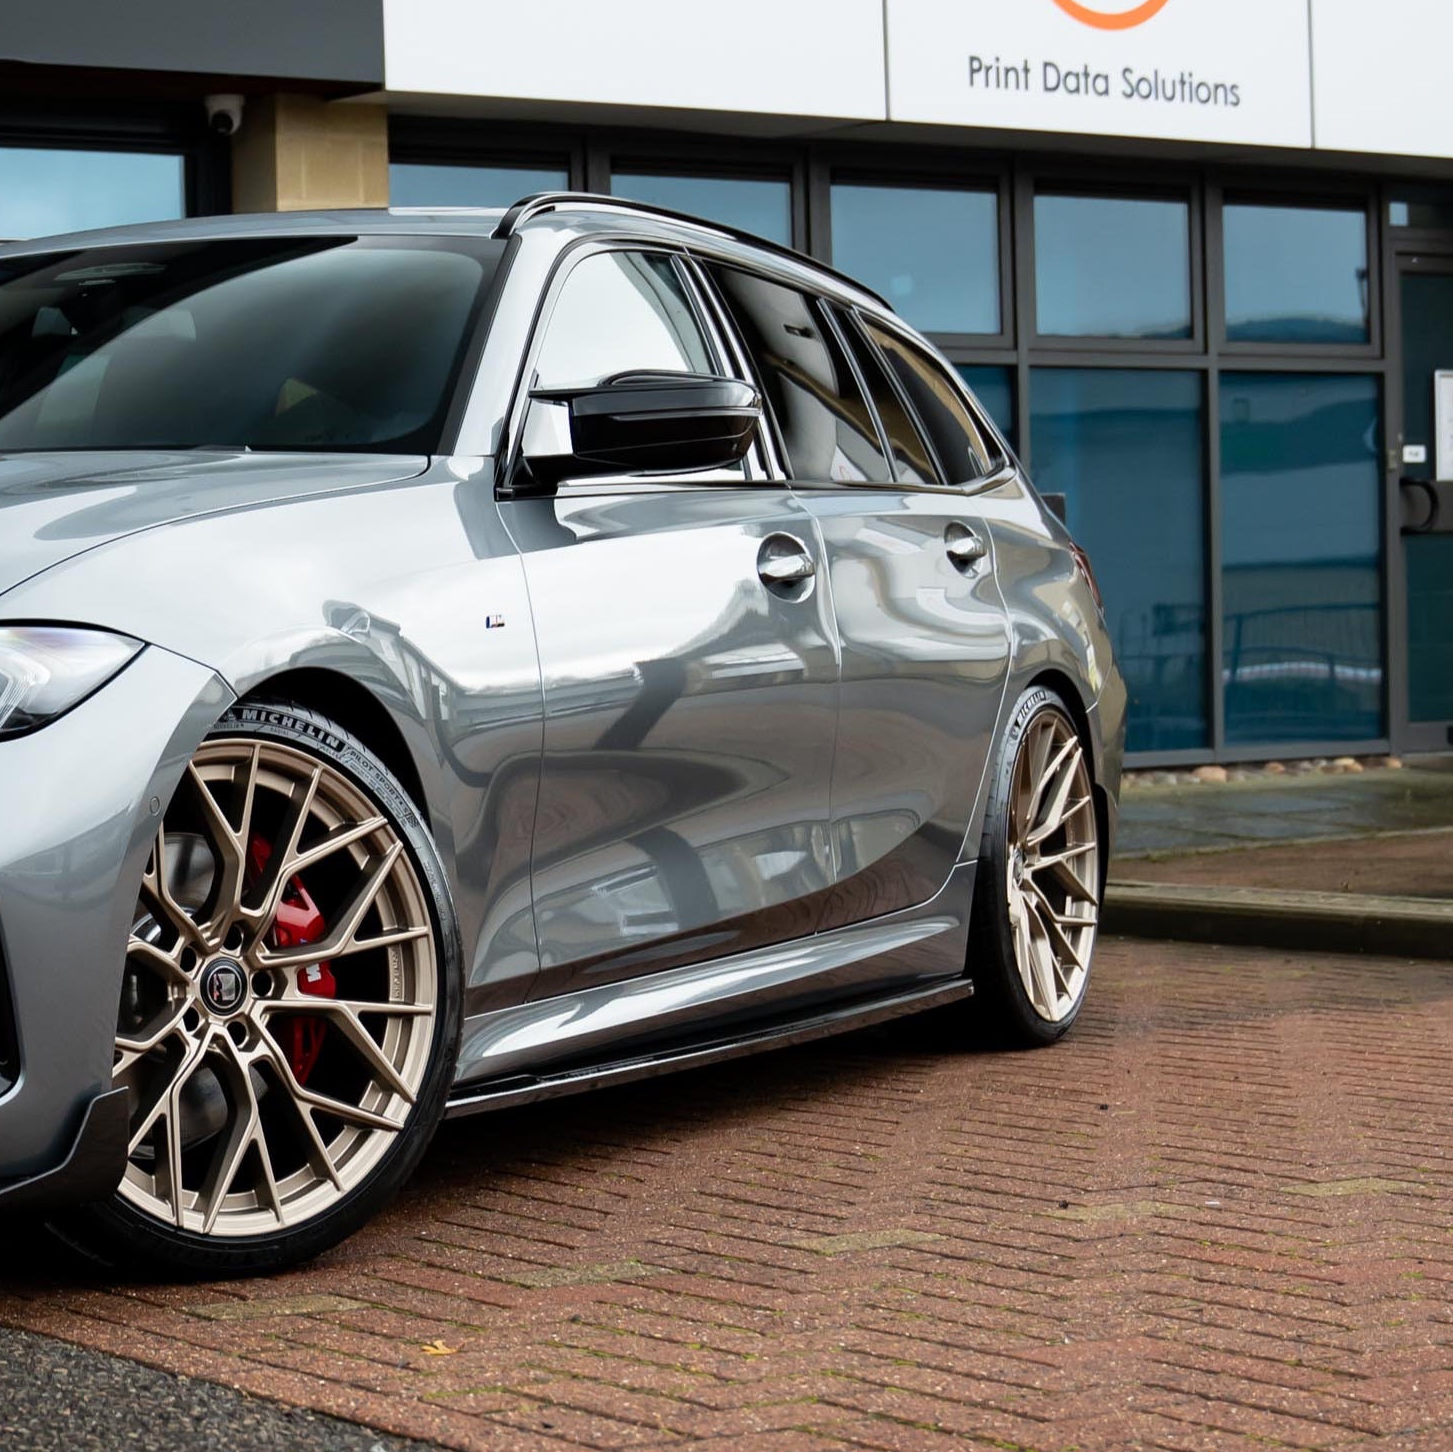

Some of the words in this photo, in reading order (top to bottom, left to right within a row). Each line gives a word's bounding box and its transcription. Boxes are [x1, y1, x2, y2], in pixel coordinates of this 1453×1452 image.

[969, 55, 1031, 91] Print
[1043, 61, 1110, 97] Data
[1121, 67, 1241, 107] Solutions
[242, 708, 340, 749] MICHELIN
[350, 750, 374, 772] PILOT
[375, 772, 400, 800] SPORT
